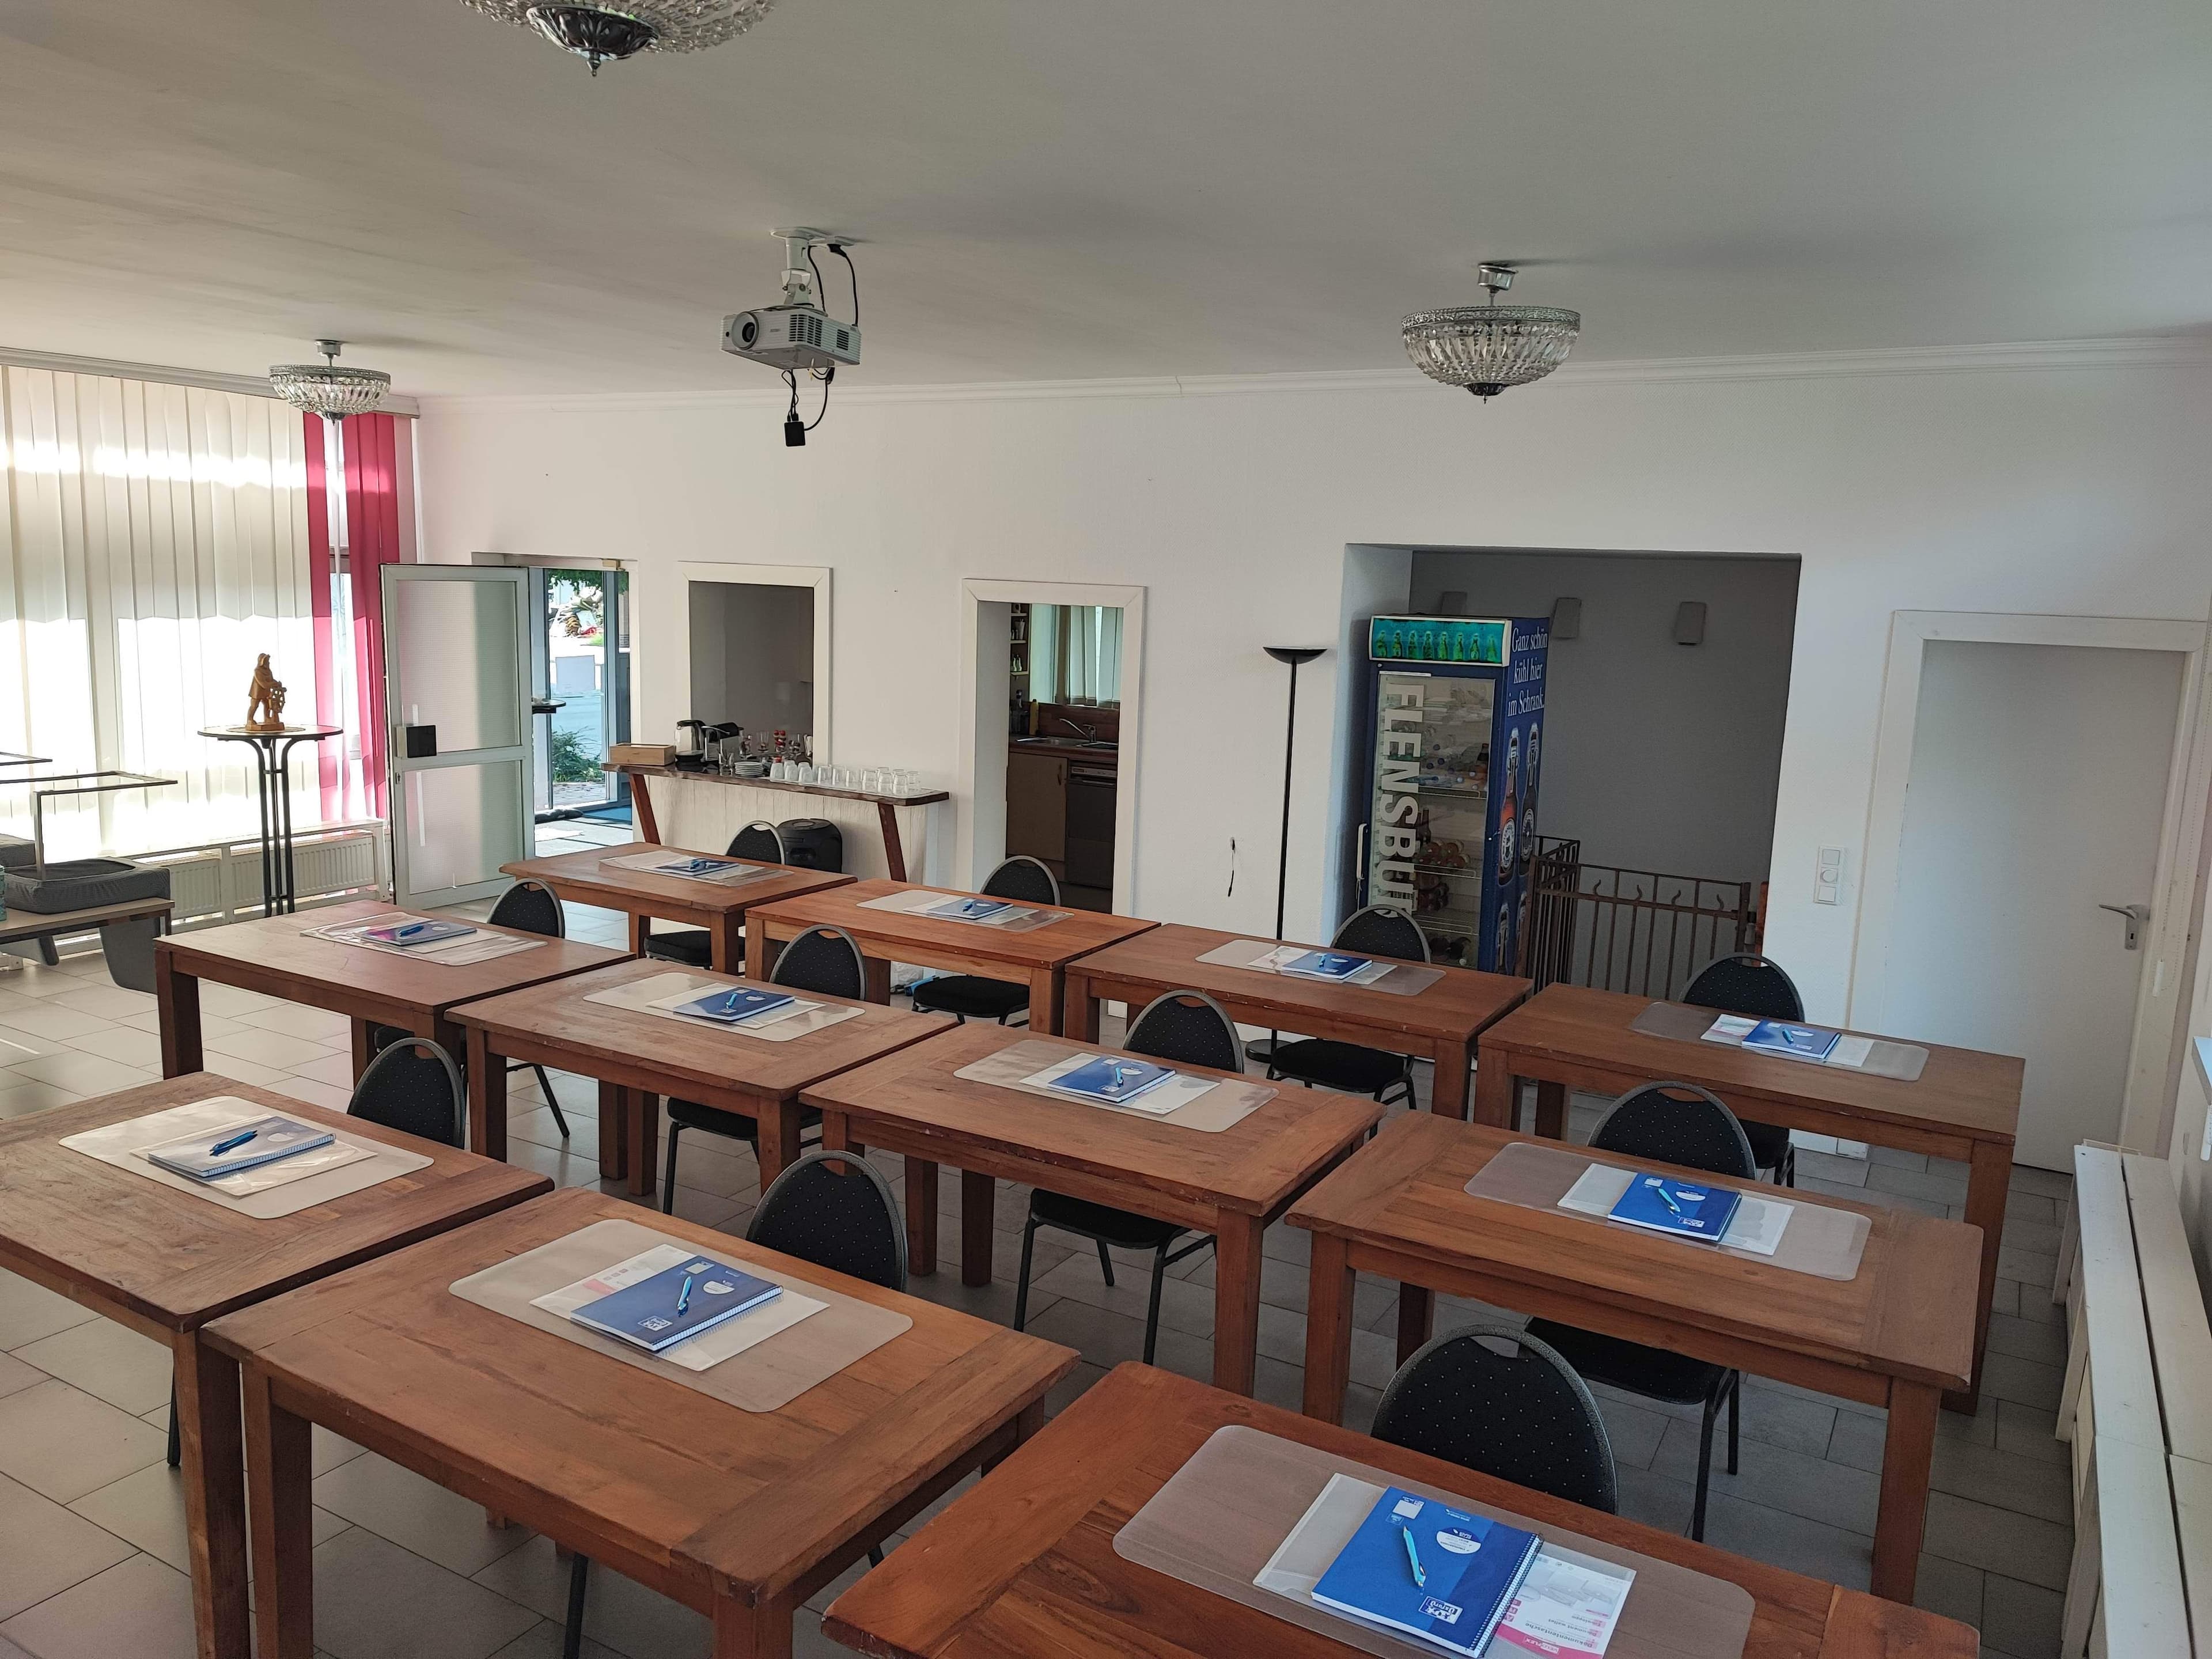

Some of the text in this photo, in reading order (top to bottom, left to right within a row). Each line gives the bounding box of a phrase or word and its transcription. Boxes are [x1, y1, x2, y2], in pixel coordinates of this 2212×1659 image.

[1512, 626, 1548, 653] Ganz schön
[1513, 657, 1543, 684] kühl hier
[1508, 687, 1545, 717] im Schrank.
[1525, 1622, 1593, 1648] Dokumententasche
